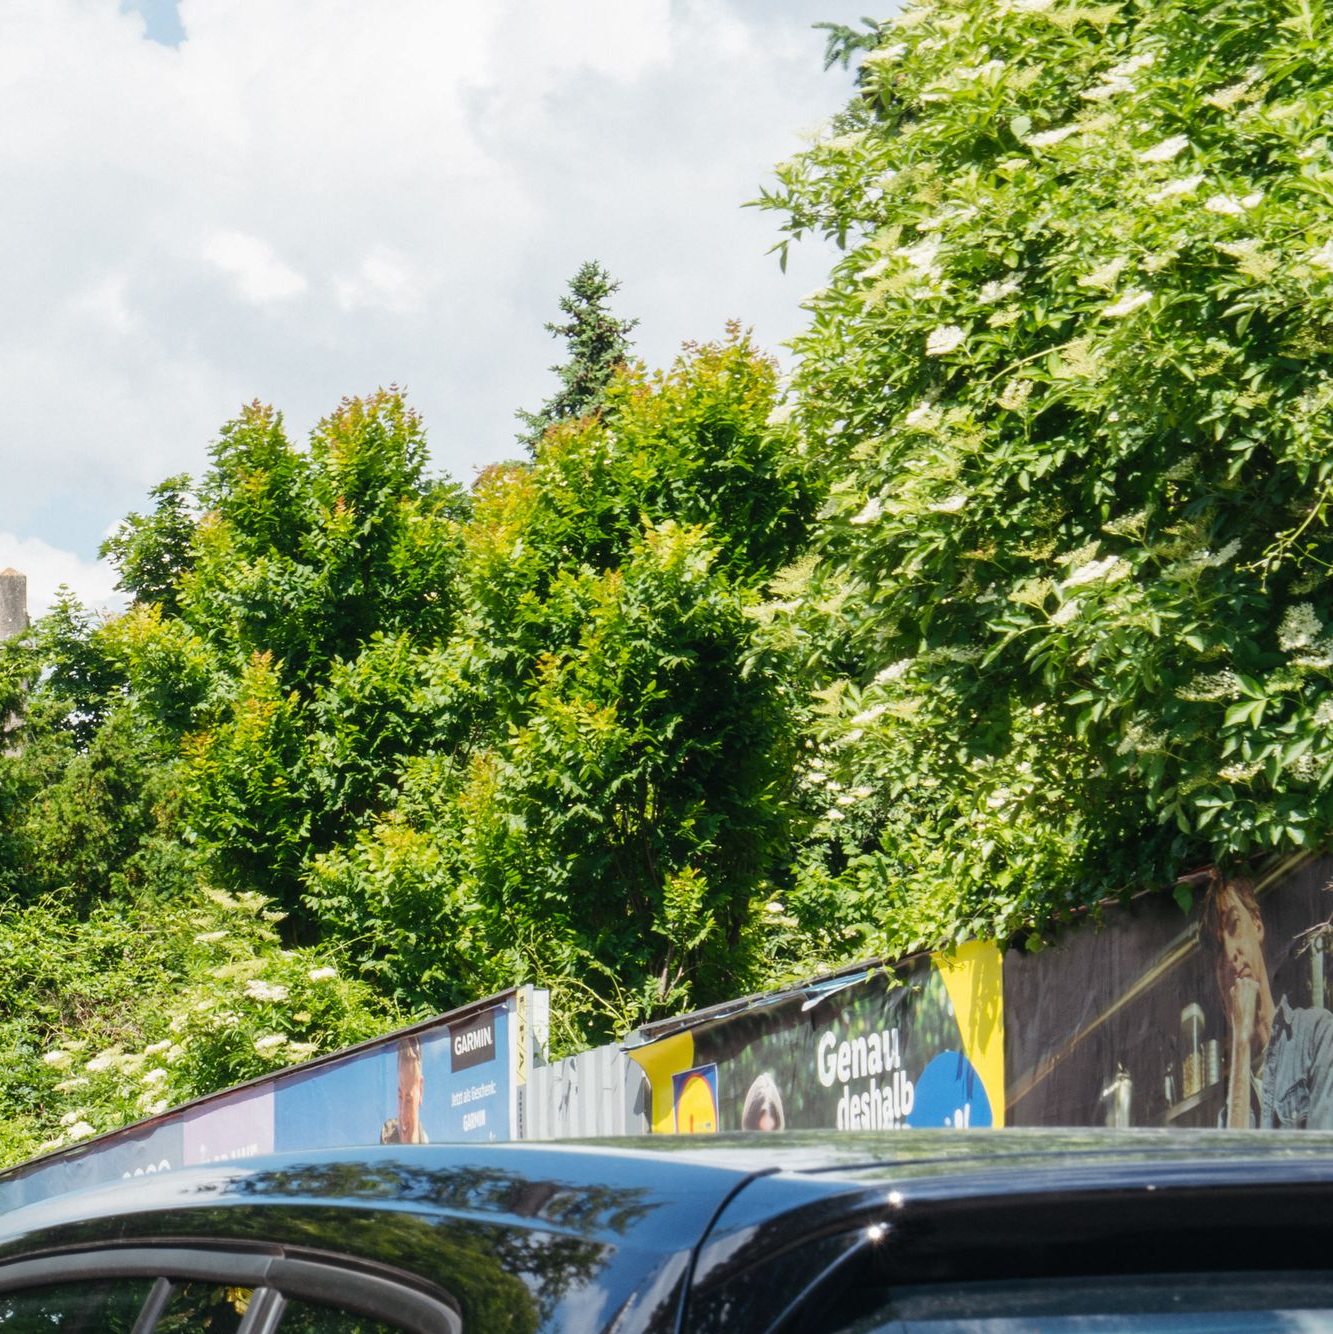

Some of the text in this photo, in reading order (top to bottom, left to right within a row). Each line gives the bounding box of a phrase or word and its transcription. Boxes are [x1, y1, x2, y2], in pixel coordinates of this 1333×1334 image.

[454, 1026, 492, 1055] GARMIN
[817, 1027, 901, 1088] Genau
[463, 1109, 485, 1132] GARMIN
[836, 1070, 914, 1130] deshalb
